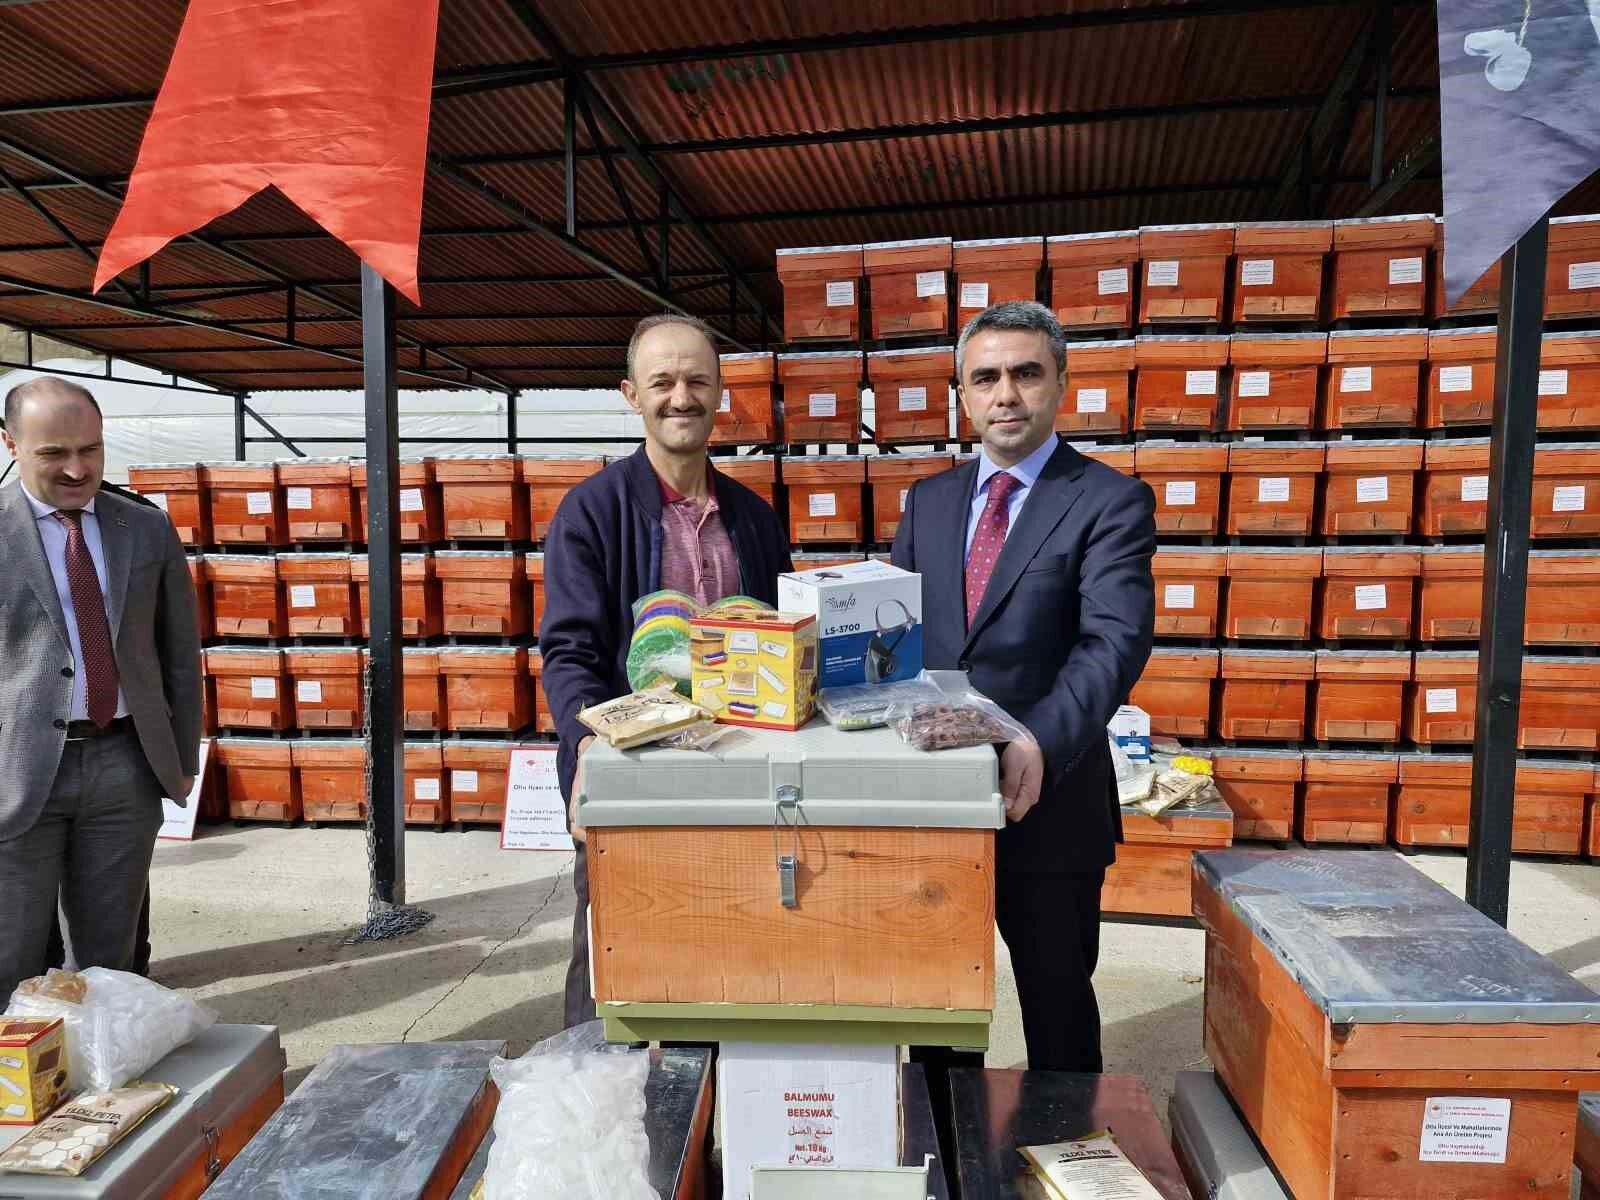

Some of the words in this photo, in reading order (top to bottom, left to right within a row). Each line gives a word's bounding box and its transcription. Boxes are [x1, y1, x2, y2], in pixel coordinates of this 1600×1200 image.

[825, 623, 860, 635] LS-3700
[784, 1093, 834, 1102] BALMUMU
[787, 1109, 833, 1118] BEESWAX
